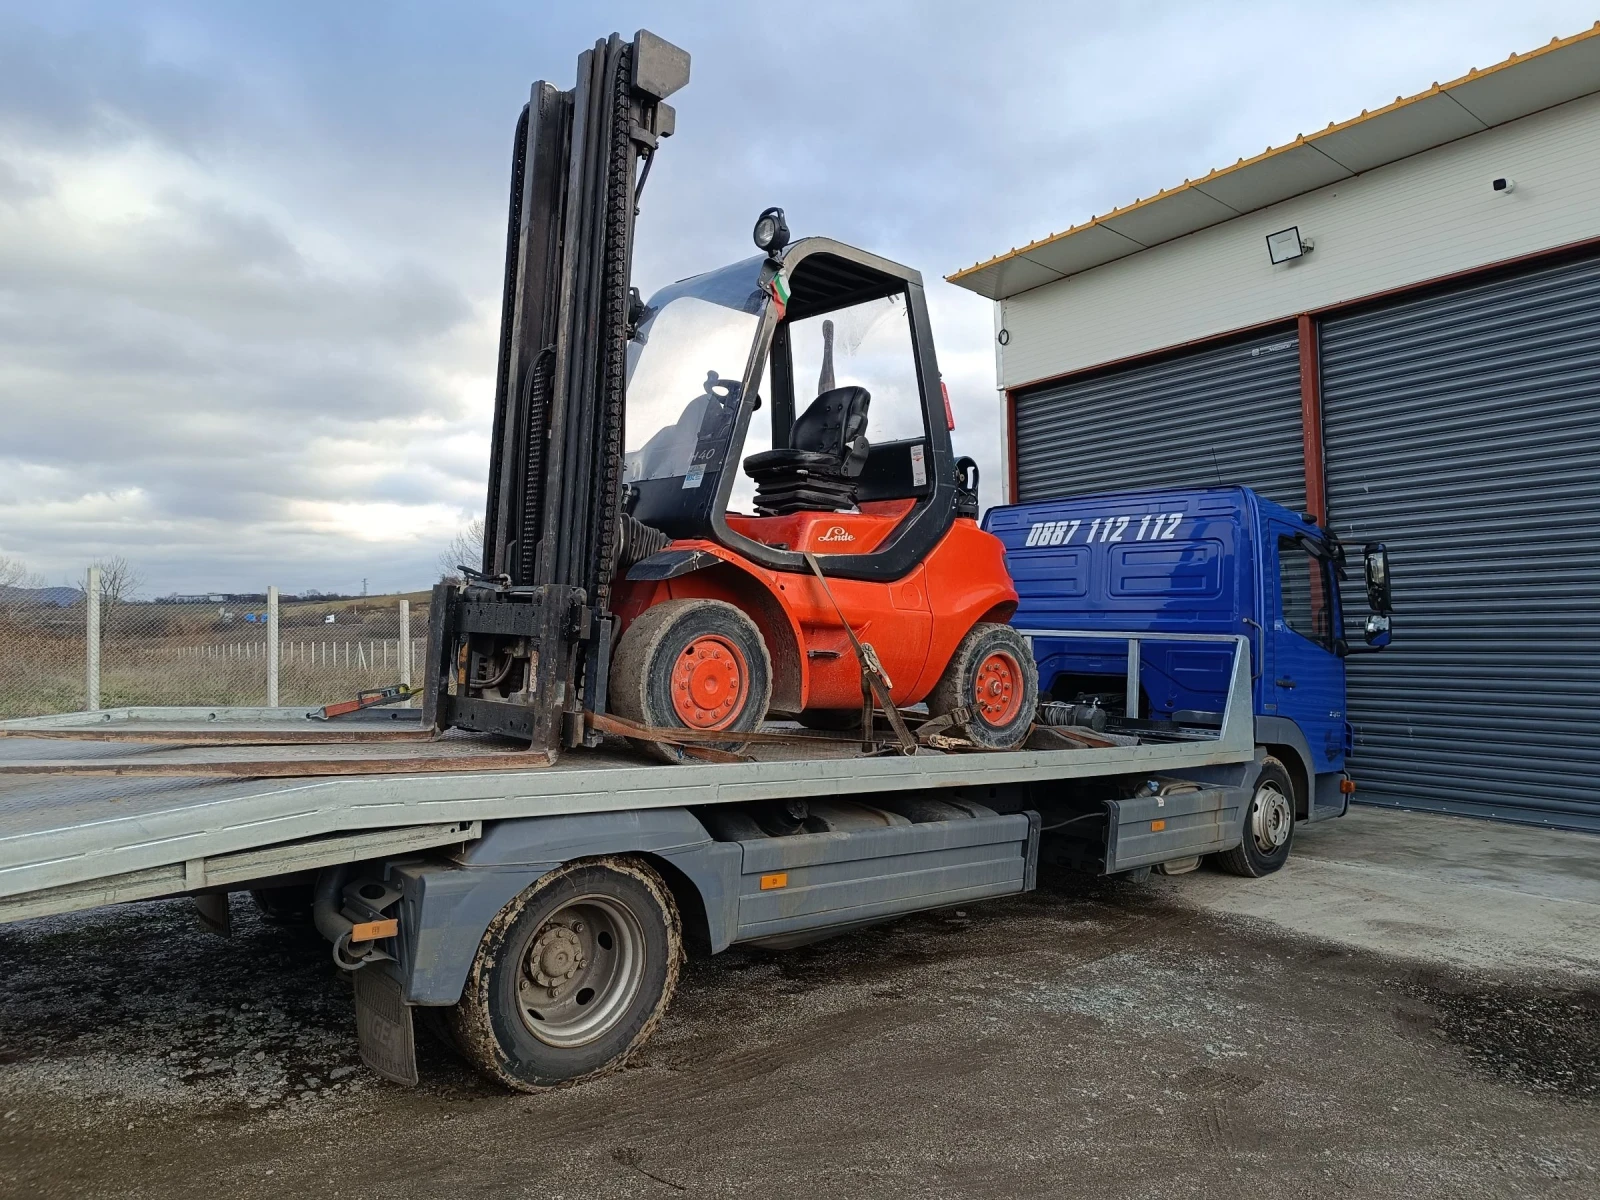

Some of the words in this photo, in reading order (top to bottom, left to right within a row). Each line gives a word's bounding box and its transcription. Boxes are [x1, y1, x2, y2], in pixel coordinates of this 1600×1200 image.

[817, 526, 856, 542] Linde
[1025, 520, 1081, 547] 0887
[1086, 517, 1130, 543] 112
[1136, 513, 1184, 541] 112
